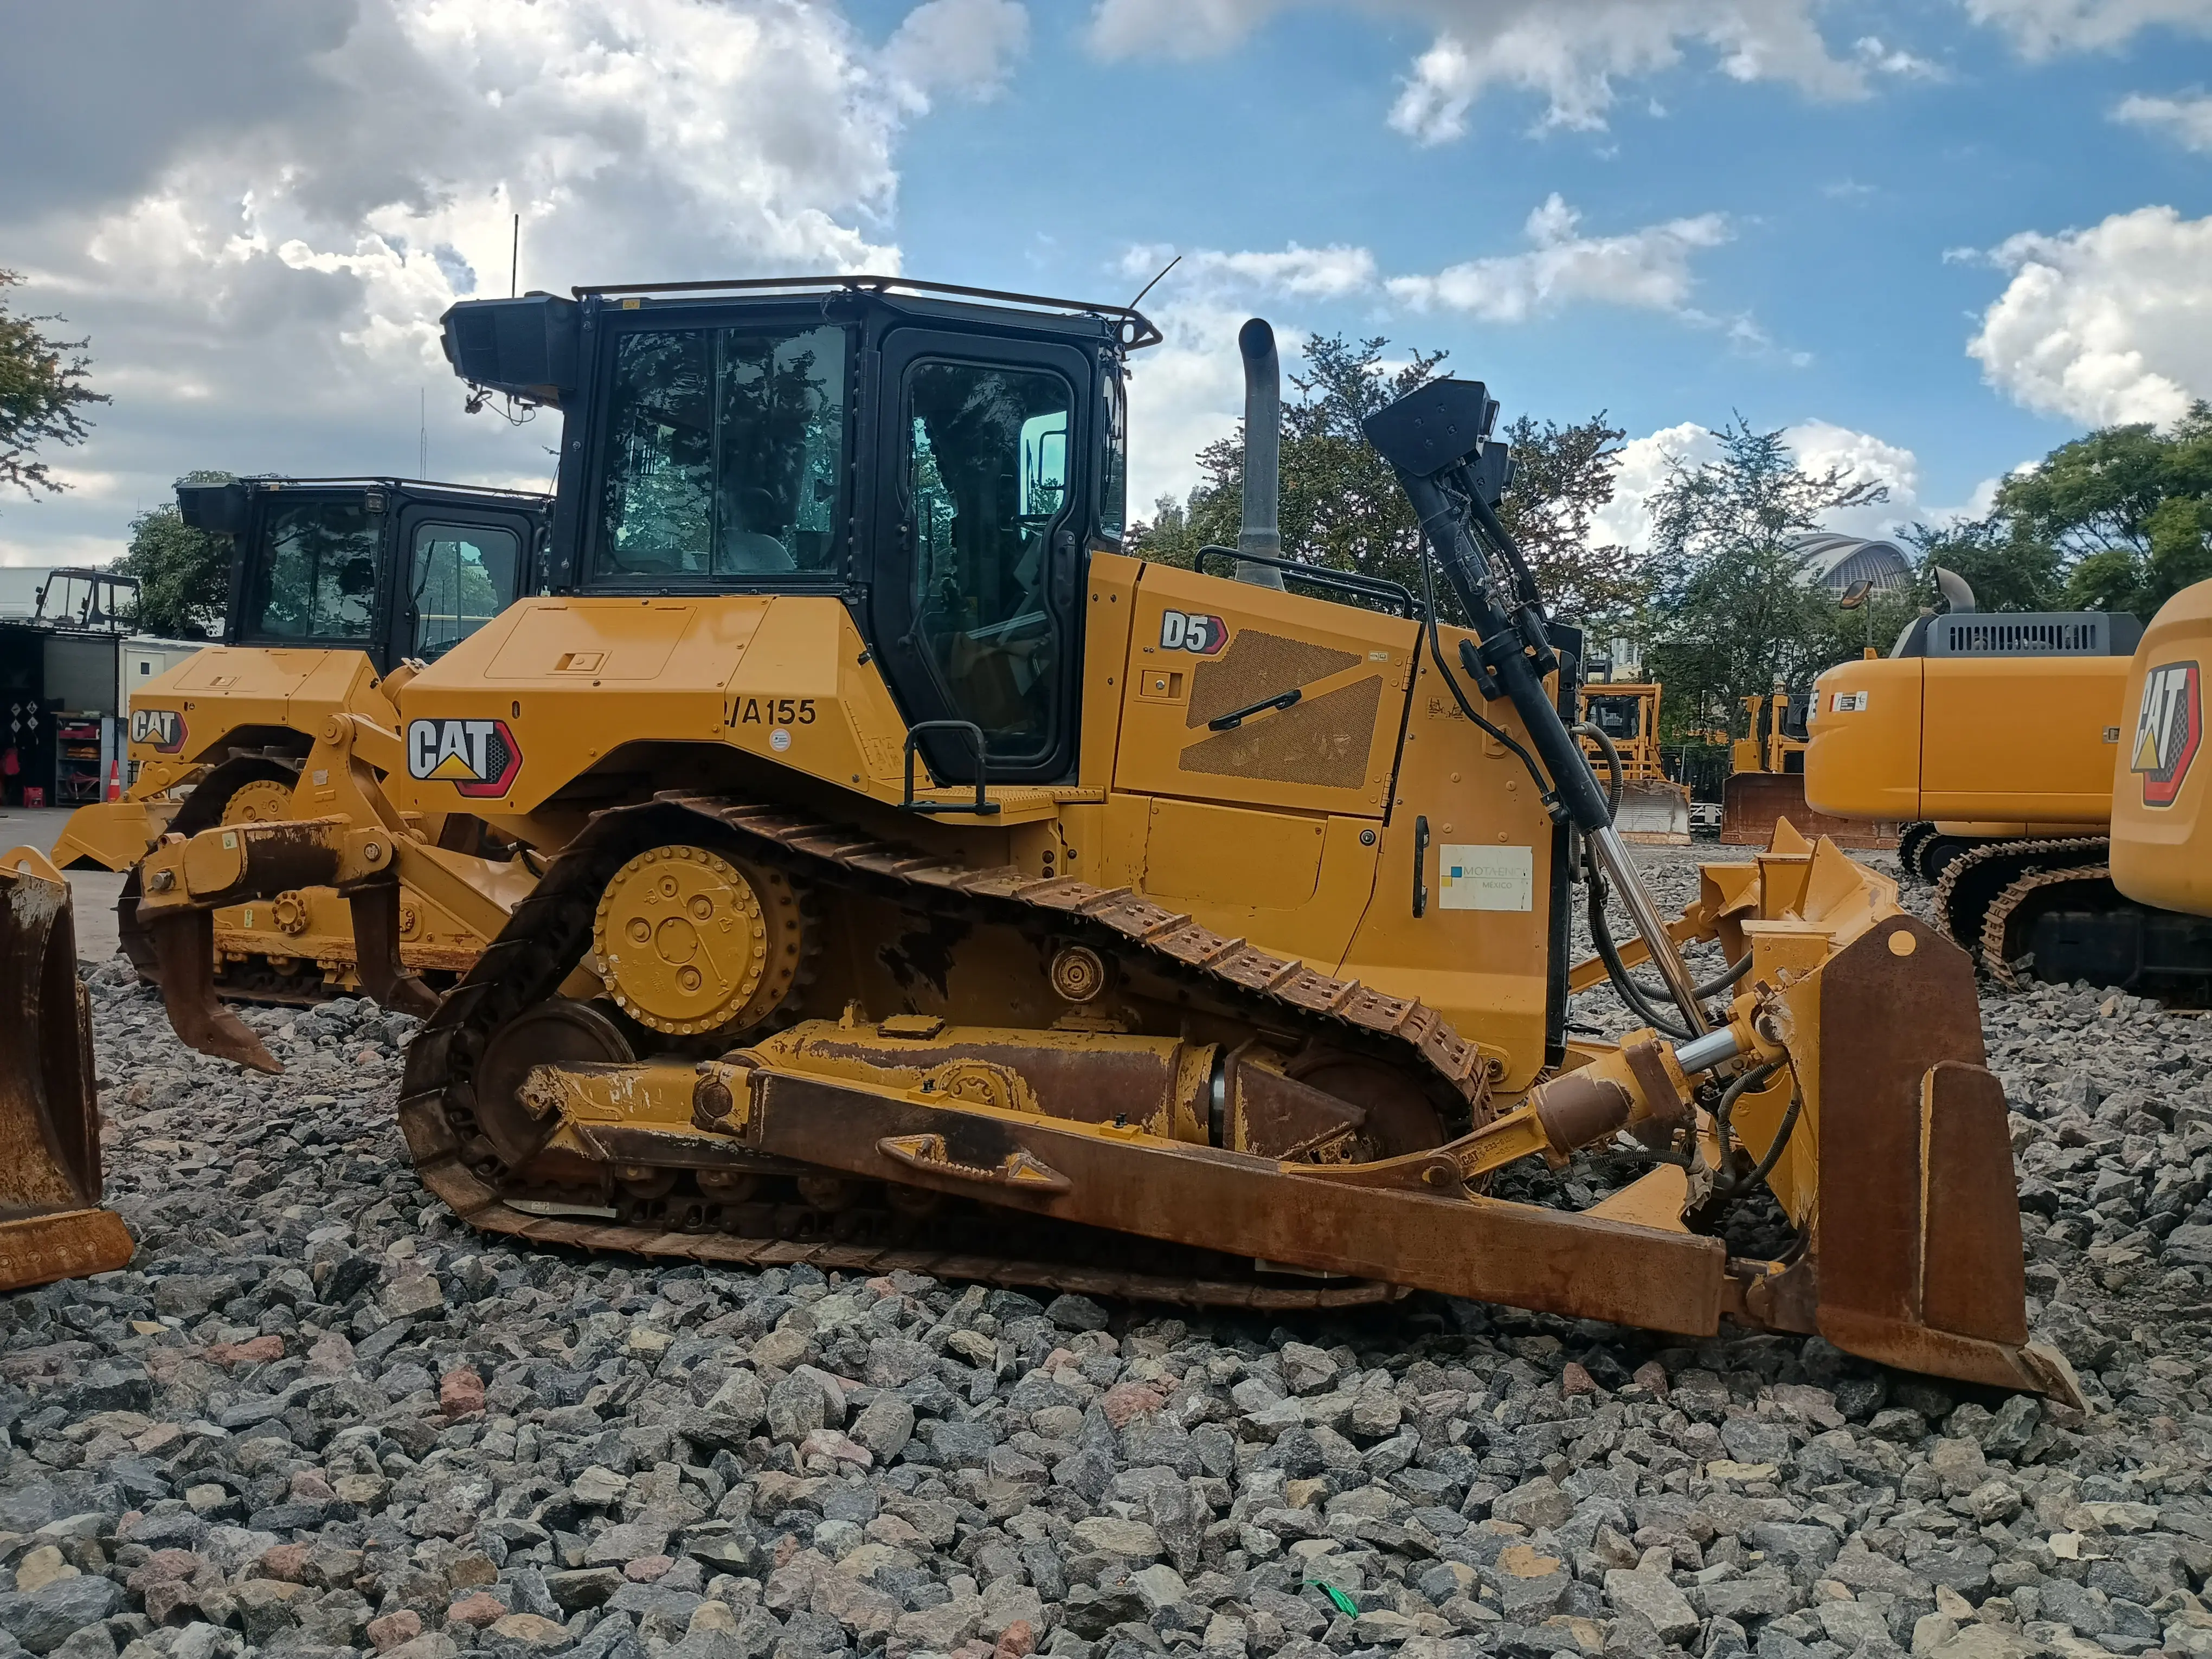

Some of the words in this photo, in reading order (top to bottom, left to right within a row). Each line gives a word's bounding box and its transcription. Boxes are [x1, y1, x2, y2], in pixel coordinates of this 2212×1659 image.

[1162, 612, 1208, 651] D5
[132, 710, 175, 743] CAT
[2131, 668, 2187, 769] CAT
[409, 720, 493, 779] CAT
[1461, 1150, 1480, 1166] CAT
